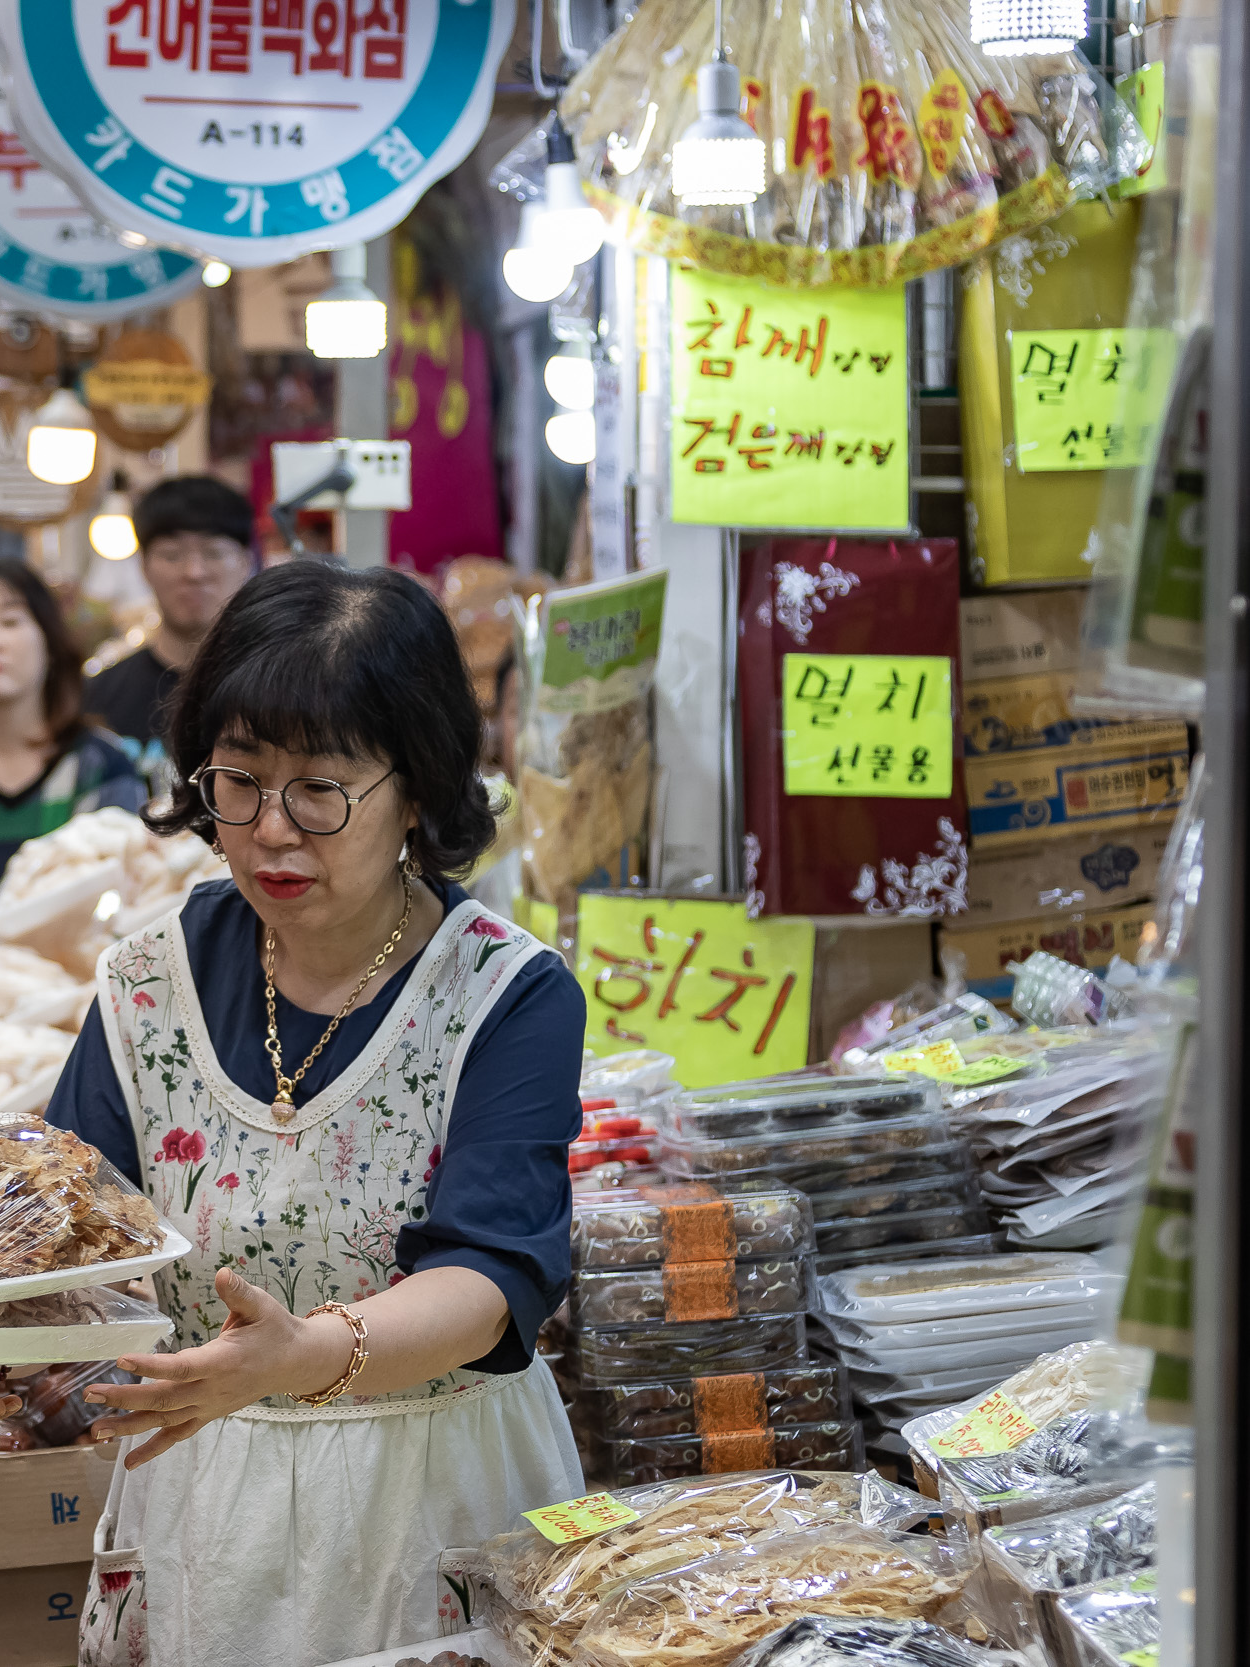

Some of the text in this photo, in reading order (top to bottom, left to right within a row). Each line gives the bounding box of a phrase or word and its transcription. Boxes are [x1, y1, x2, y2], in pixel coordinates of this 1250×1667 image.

[201, 119, 305, 147] A-114
[85, 116, 427, 236] 카드가맹점
[686, 300, 828, 378] 참깨
[682, 412, 826, 473] 검은깨
[795, 663, 928, 730] 멸치
[827, 742, 932, 786] 선물용
[592, 915, 796, 1055] 한치
